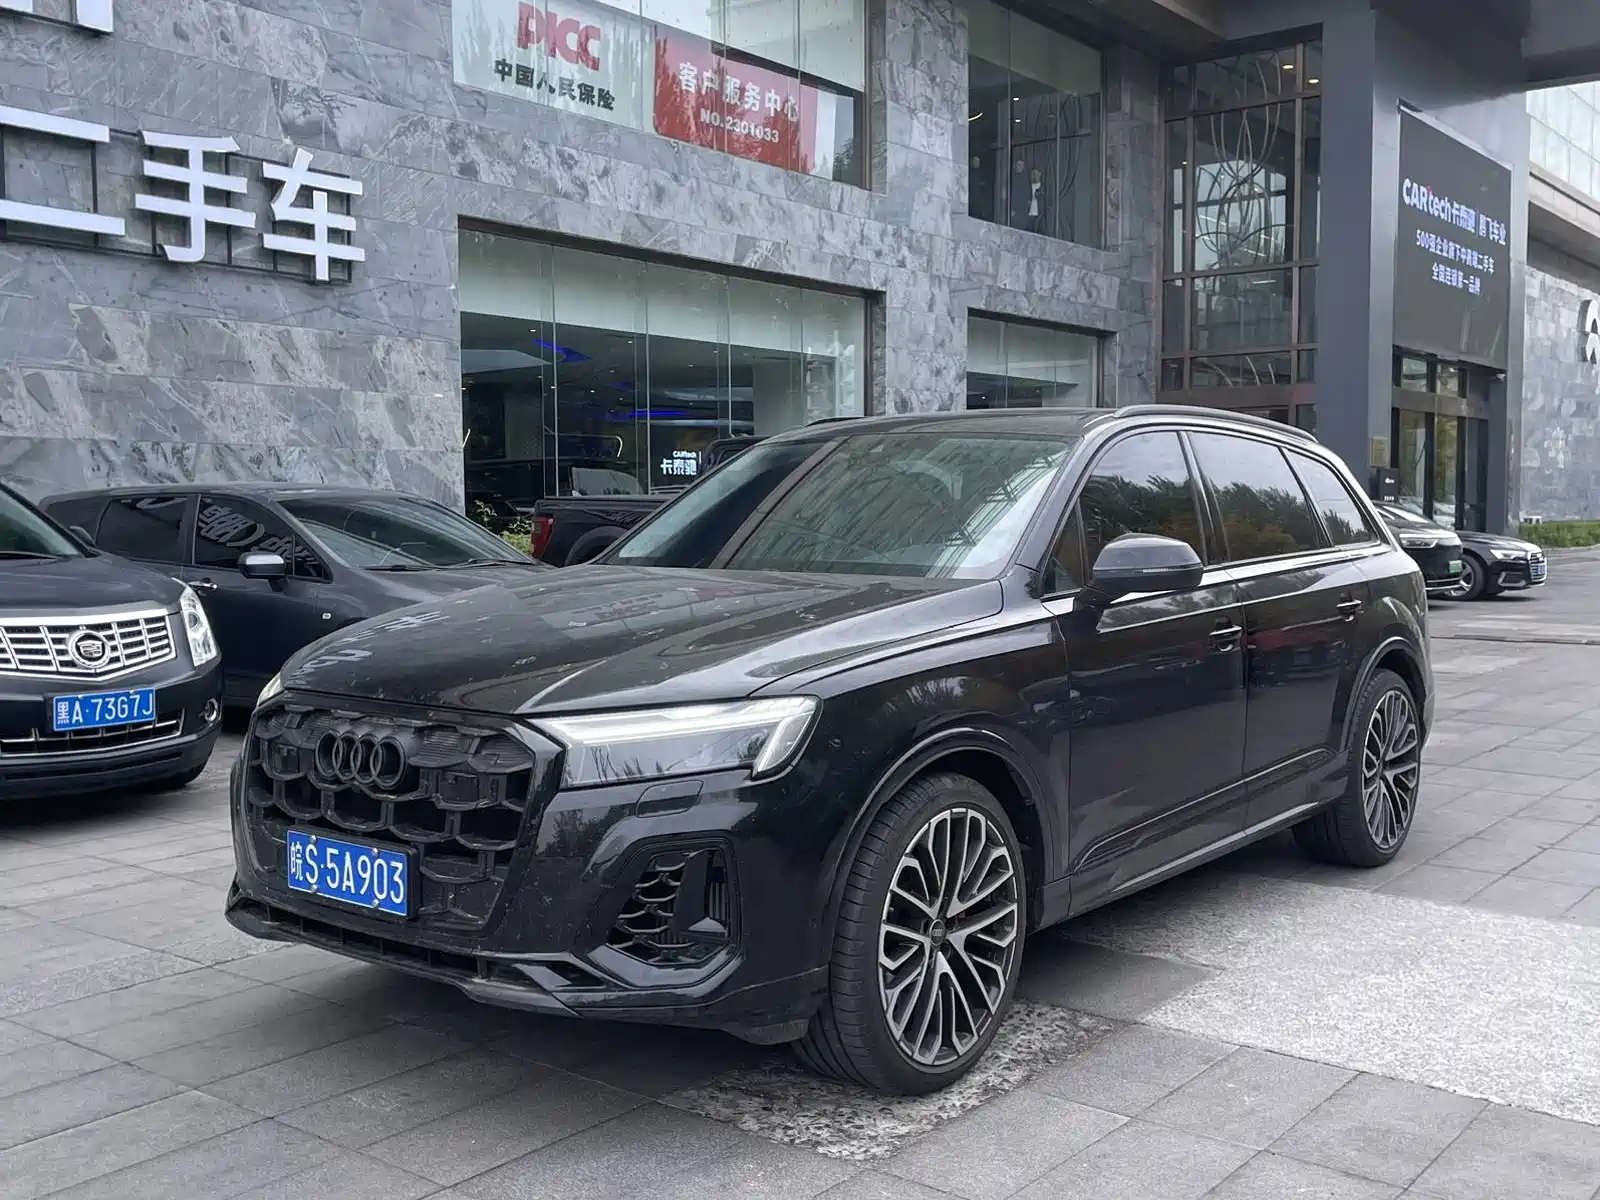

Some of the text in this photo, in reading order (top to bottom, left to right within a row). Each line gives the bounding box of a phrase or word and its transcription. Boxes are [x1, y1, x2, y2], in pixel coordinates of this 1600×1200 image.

[516, 1, 600, 72] PICC
[494, 58, 616, 111] 中国人民保险
[679, 61, 799, 122] 客户服务中心
[0, 105, 366, 282] 二手车
